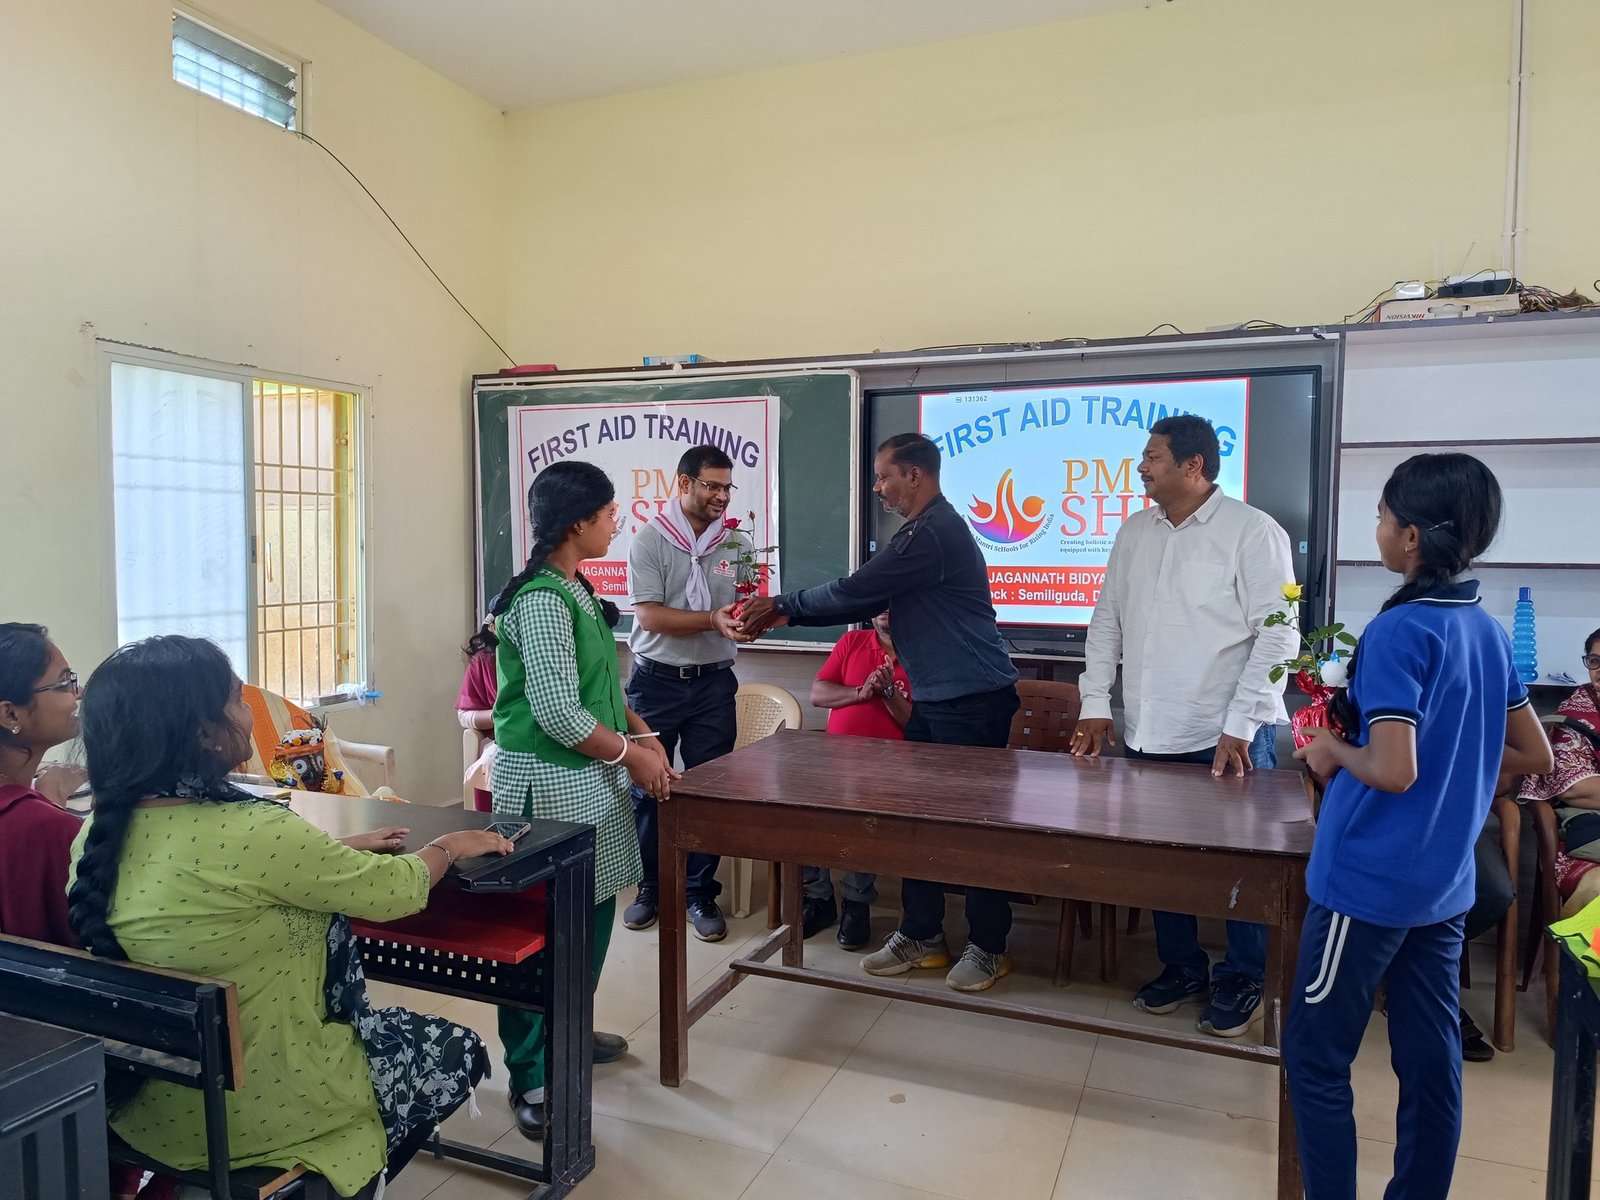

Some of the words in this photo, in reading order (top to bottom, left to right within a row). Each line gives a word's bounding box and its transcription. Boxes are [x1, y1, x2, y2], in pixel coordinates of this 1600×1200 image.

[528, 422, 590, 473] FIRST
[598, 414, 636, 444] AID
[643, 413, 760, 468] TRAINING
[1019, 398, 1071, 432] AID
[1081, 395, 1237, 457] TRAIG
[631, 468, 680, 499] PM
[1062, 458, 1135, 494] PM
[1019, 542, 1029, 550] for
[1028, 528, 1047, 545] Rising
[1043, 513, 1055, 530] India
[988, 571, 1065, 584] JAGANNATH
[1018, 588, 1089, 604] Semiliguda,
